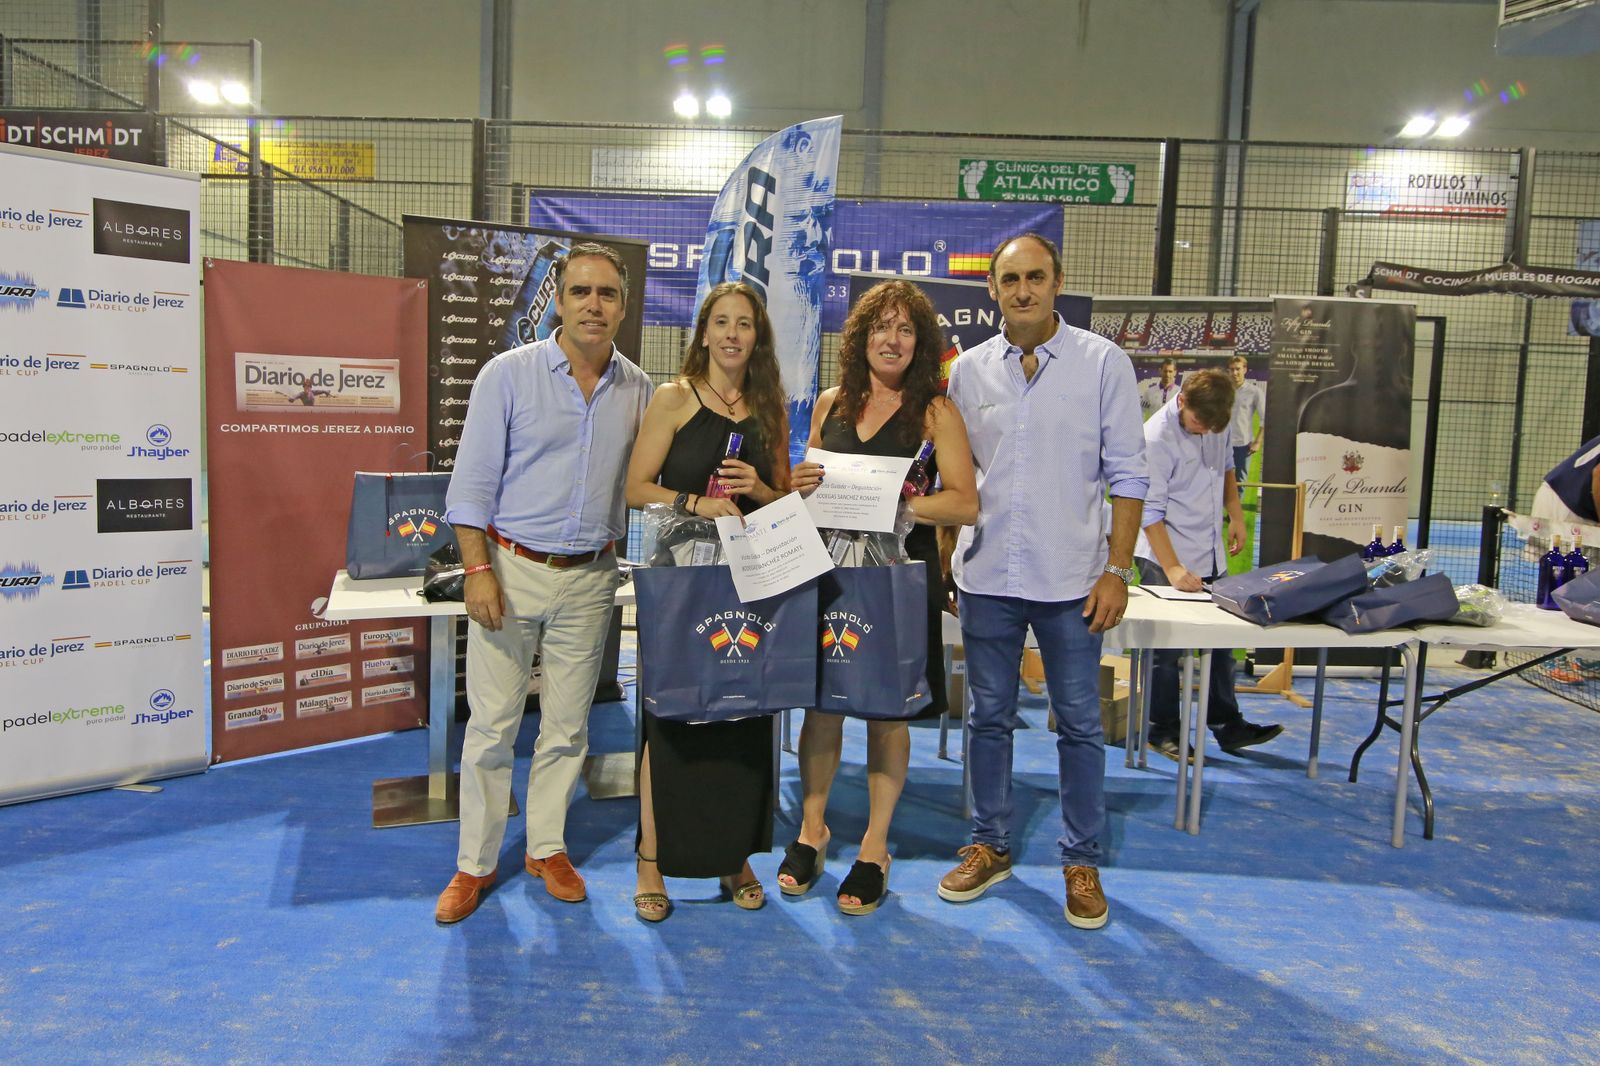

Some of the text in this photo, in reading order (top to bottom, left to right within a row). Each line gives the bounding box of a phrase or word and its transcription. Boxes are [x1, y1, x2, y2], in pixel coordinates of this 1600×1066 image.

[1050, 165, 1073, 175] DEL
[1078, 165, 1100, 176] PIE
[993, 174, 1100, 191] ATLÁNTICO
[1408, 174, 1482, 189] ROTULOS Y
[1448, 191, 1507, 206] LUMINOS
[26, 210, 44, 224] de
[48, 213, 83, 228] Jerez
[103, 221, 182, 240] ALBORES
[122, 238, 163, 247] RESTAURANTE
[1485, 271, 1536, 282] MUEBLES
[1537, 273, 1553, 283] DE
[1555, 275, 1600, 286] HOGAR
[88, 289, 184, 309] Diario de Jerez
[90, 303, 147, 313] PADEL CUP
[23, 355, 42, 368] de
[45, 356, 80, 372] Jerez
[245, 364, 384, 392] Diario de Jerez
[220, 423, 415, 434] COMPARTIMOS JEREZ A DIARIO
[81, 444, 98, 452] puro
[1304, 472, 1407, 509] Fifty Pounds
[31, 499, 49, 512] de
[53, 500, 87, 514] Jerez
[106, 499, 185, 510] ALBORES
[1338, 503, 1363, 513] GIN
[25, 513, 47, 521] CUP
[92, 565, 187, 579] Diario de Jerez
[94, 580, 125, 588] PADEL
[696, 610, 773, 634] SPAGNOLO
[29, 643, 47, 657] de
[50, 641, 84, 658] Jerez
[298, 639, 346, 651] Diario de Jerez
[226, 649, 250, 659] DIARIO
[250, 648, 260, 656] DE
[23, 657, 44, 666] CUP
[365, 659, 391, 669] Huelva
[227, 681, 249, 692] Diario
[260, 678, 283, 687] Sevilla
[364, 690, 381, 698] Diario
[3, 704, 125, 731] padelextreme
[228, 708, 262, 720] Granada
[86, 718, 103, 726] puro
